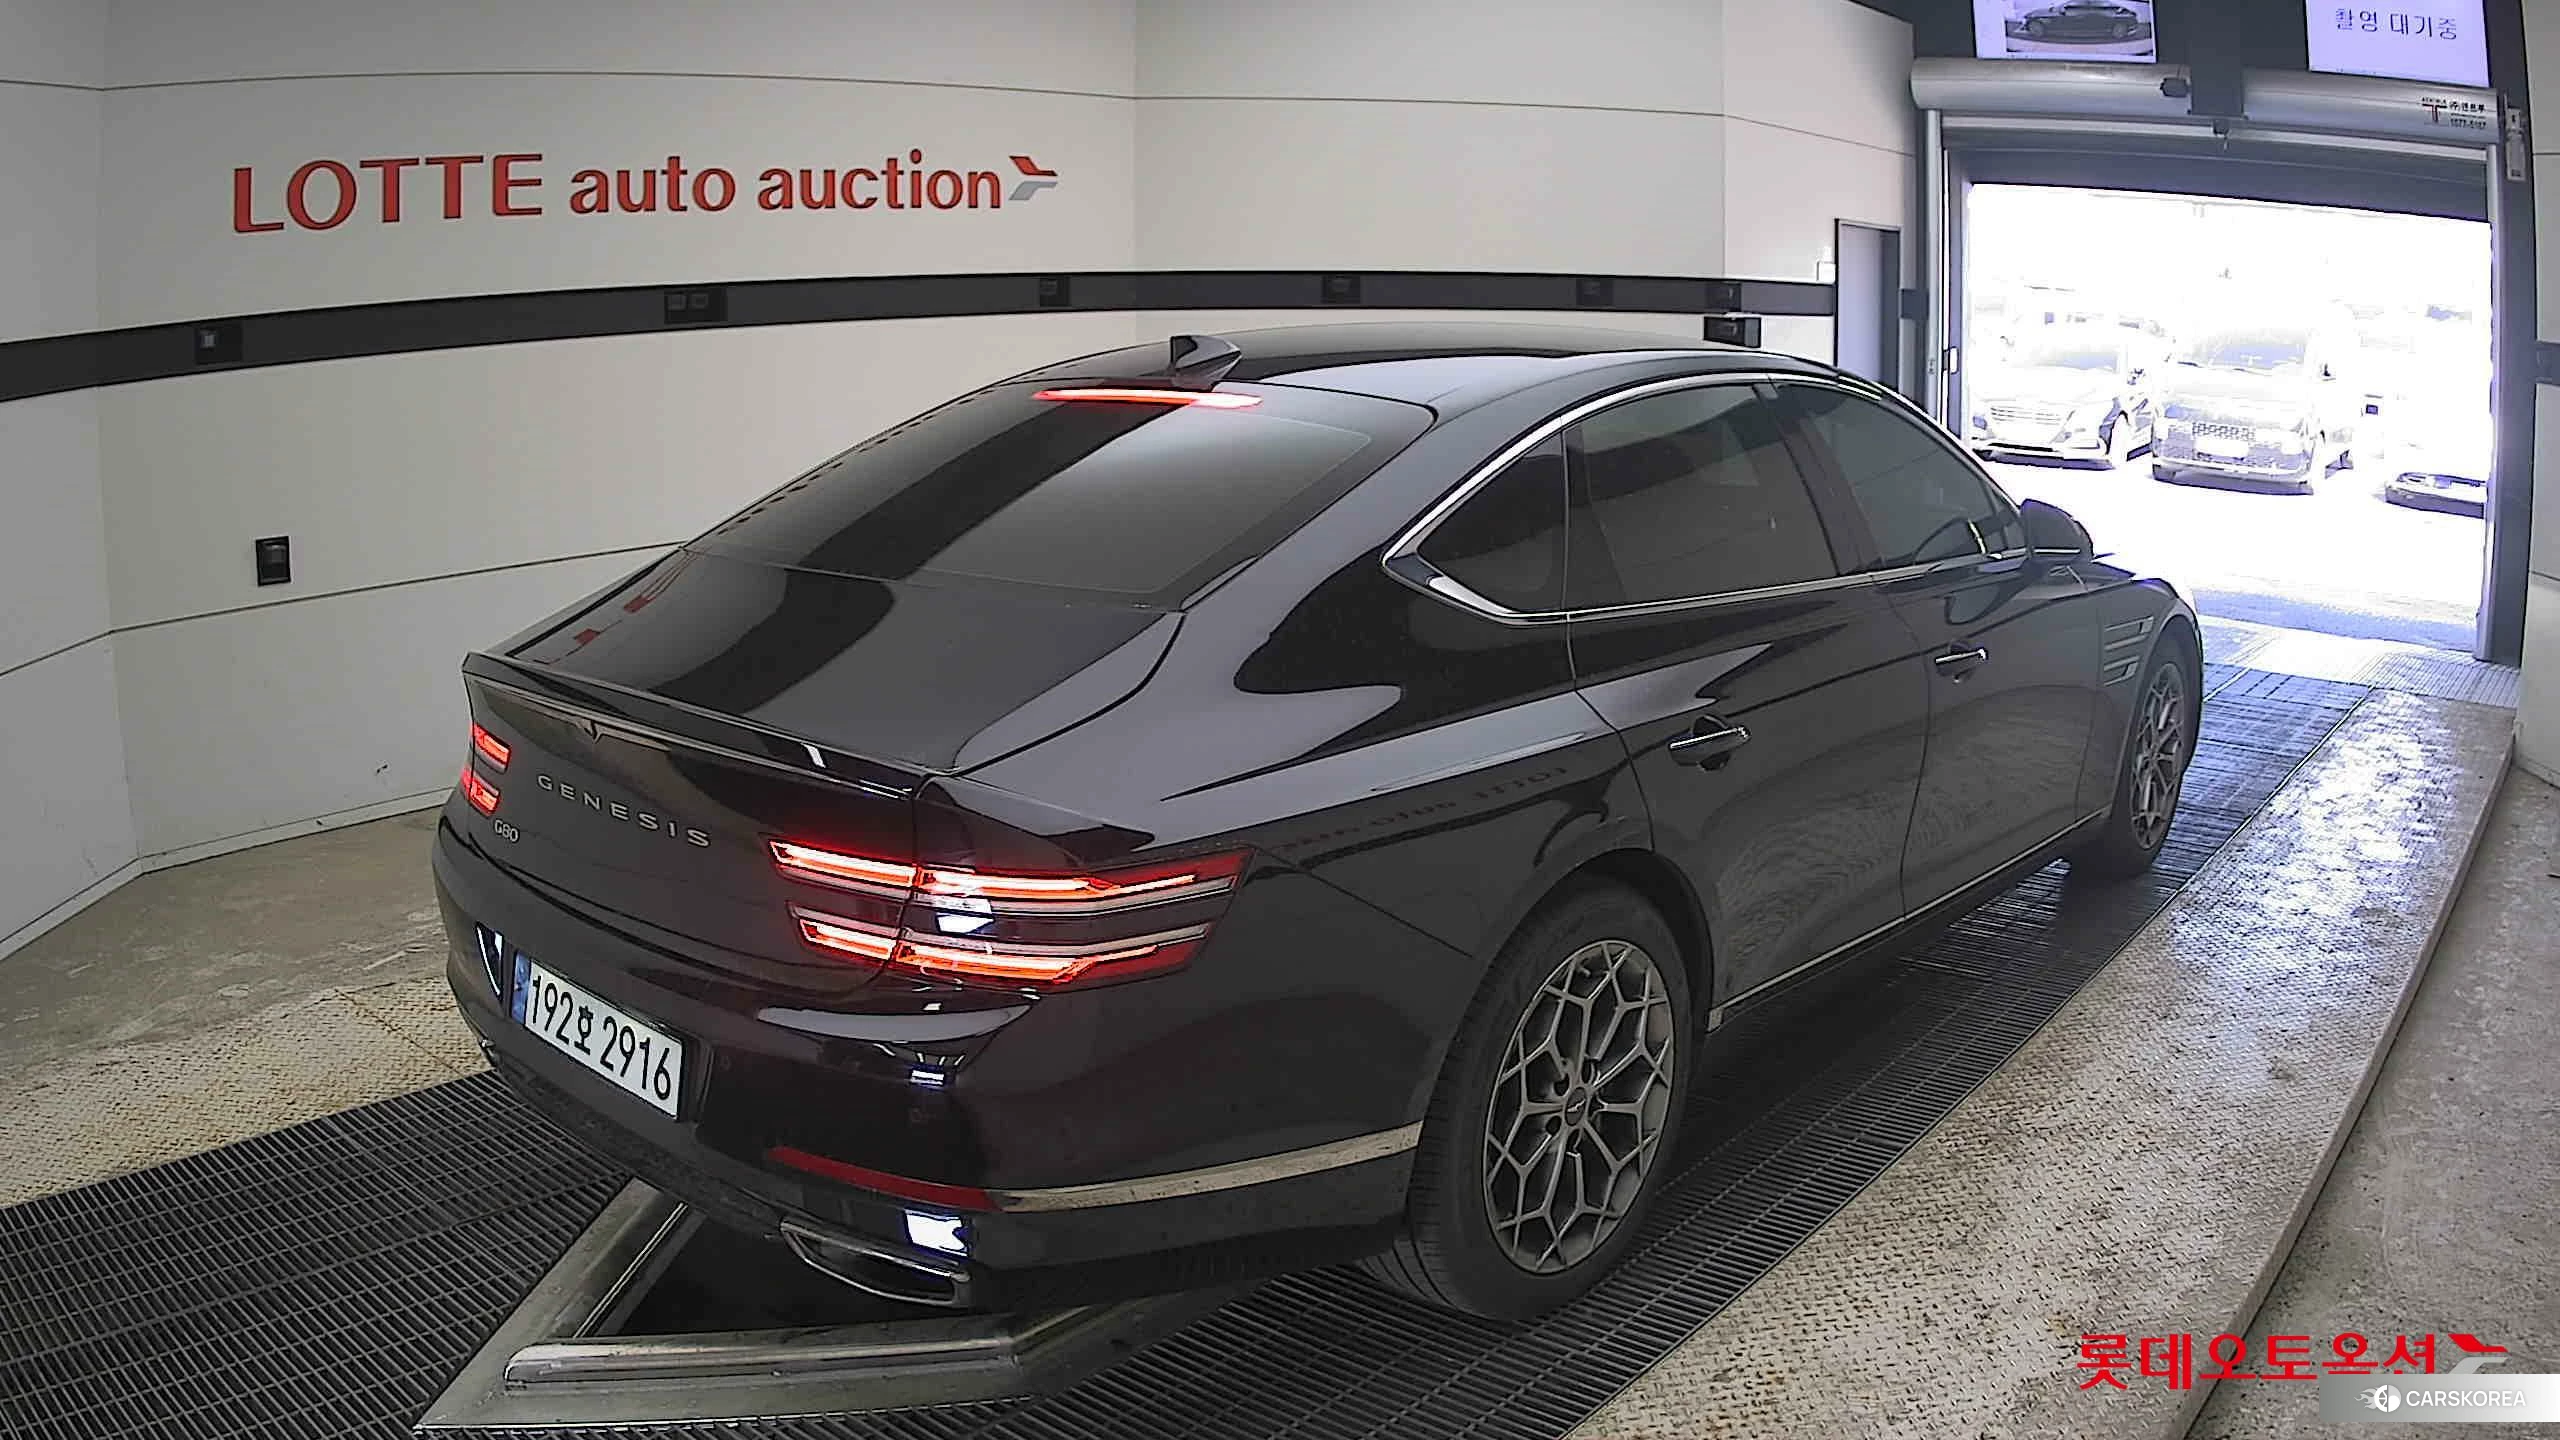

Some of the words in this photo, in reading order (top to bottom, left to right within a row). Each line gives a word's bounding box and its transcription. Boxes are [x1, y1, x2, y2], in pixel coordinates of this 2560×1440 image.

[2388, 13, 2457, 40] 대기중
[234, 154, 542, 233] LOTTE
[569, 156, 736, 214] auto
[757, 149, 1001, 210] auction
[494, 819, 519, 843] G80
[537, 775, 710, 848] GENESIS
[532, 975, 594, 1055] 192호
[600, 1015, 671, 1101] 2916
